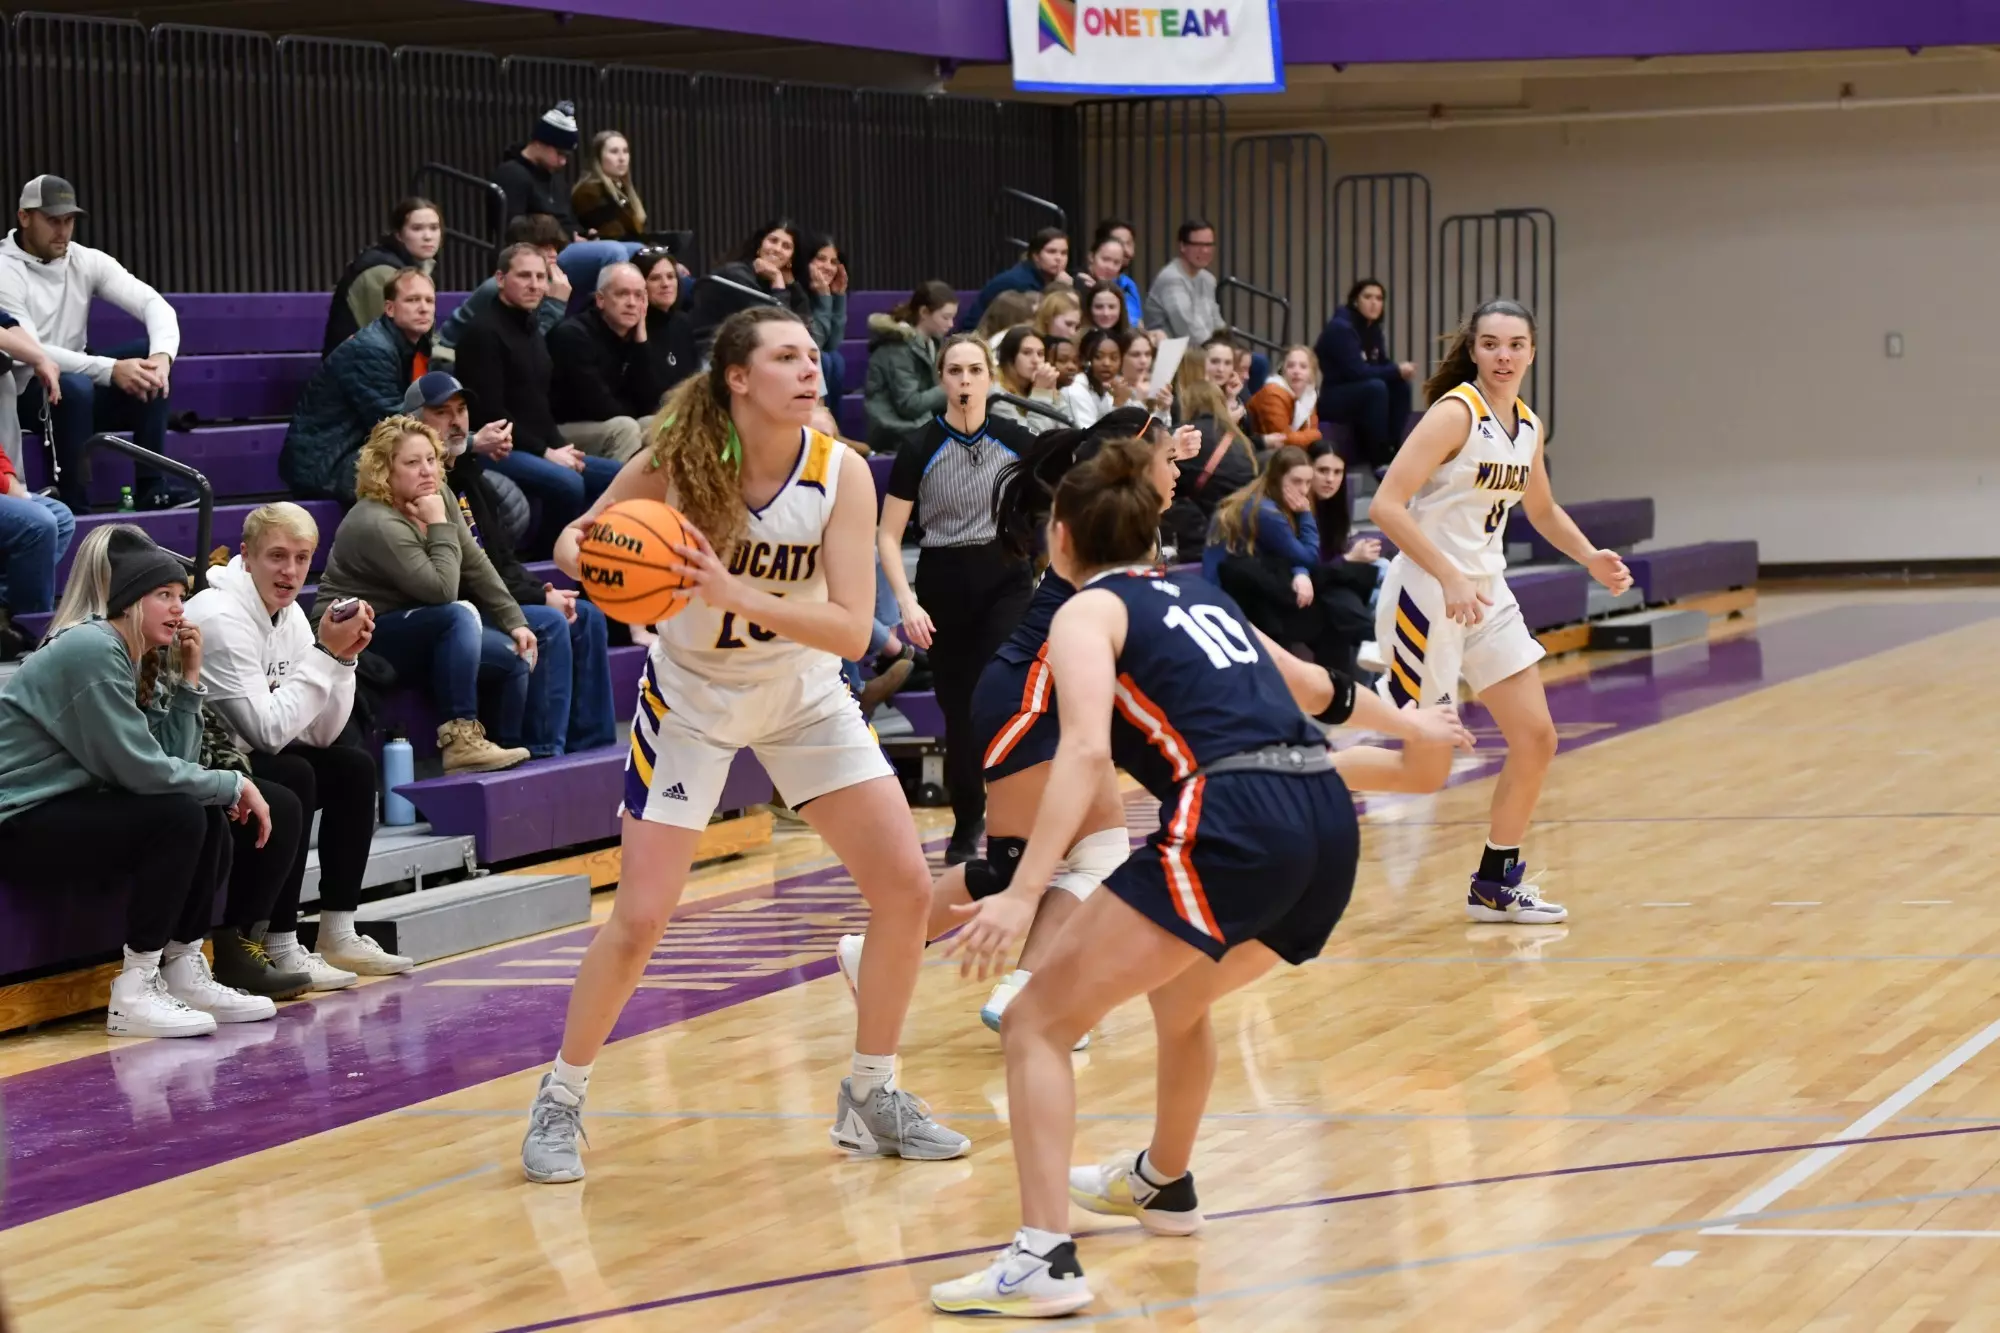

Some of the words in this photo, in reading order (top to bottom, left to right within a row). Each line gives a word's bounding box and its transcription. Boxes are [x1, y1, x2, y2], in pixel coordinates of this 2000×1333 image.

[1083, 7, 1230, 37] ONETEAM
[1474, 462, 1530, 493] WILDCAT
[1163, 604, 1259, 670] 10
[662, 791, 688, 802] adidas
